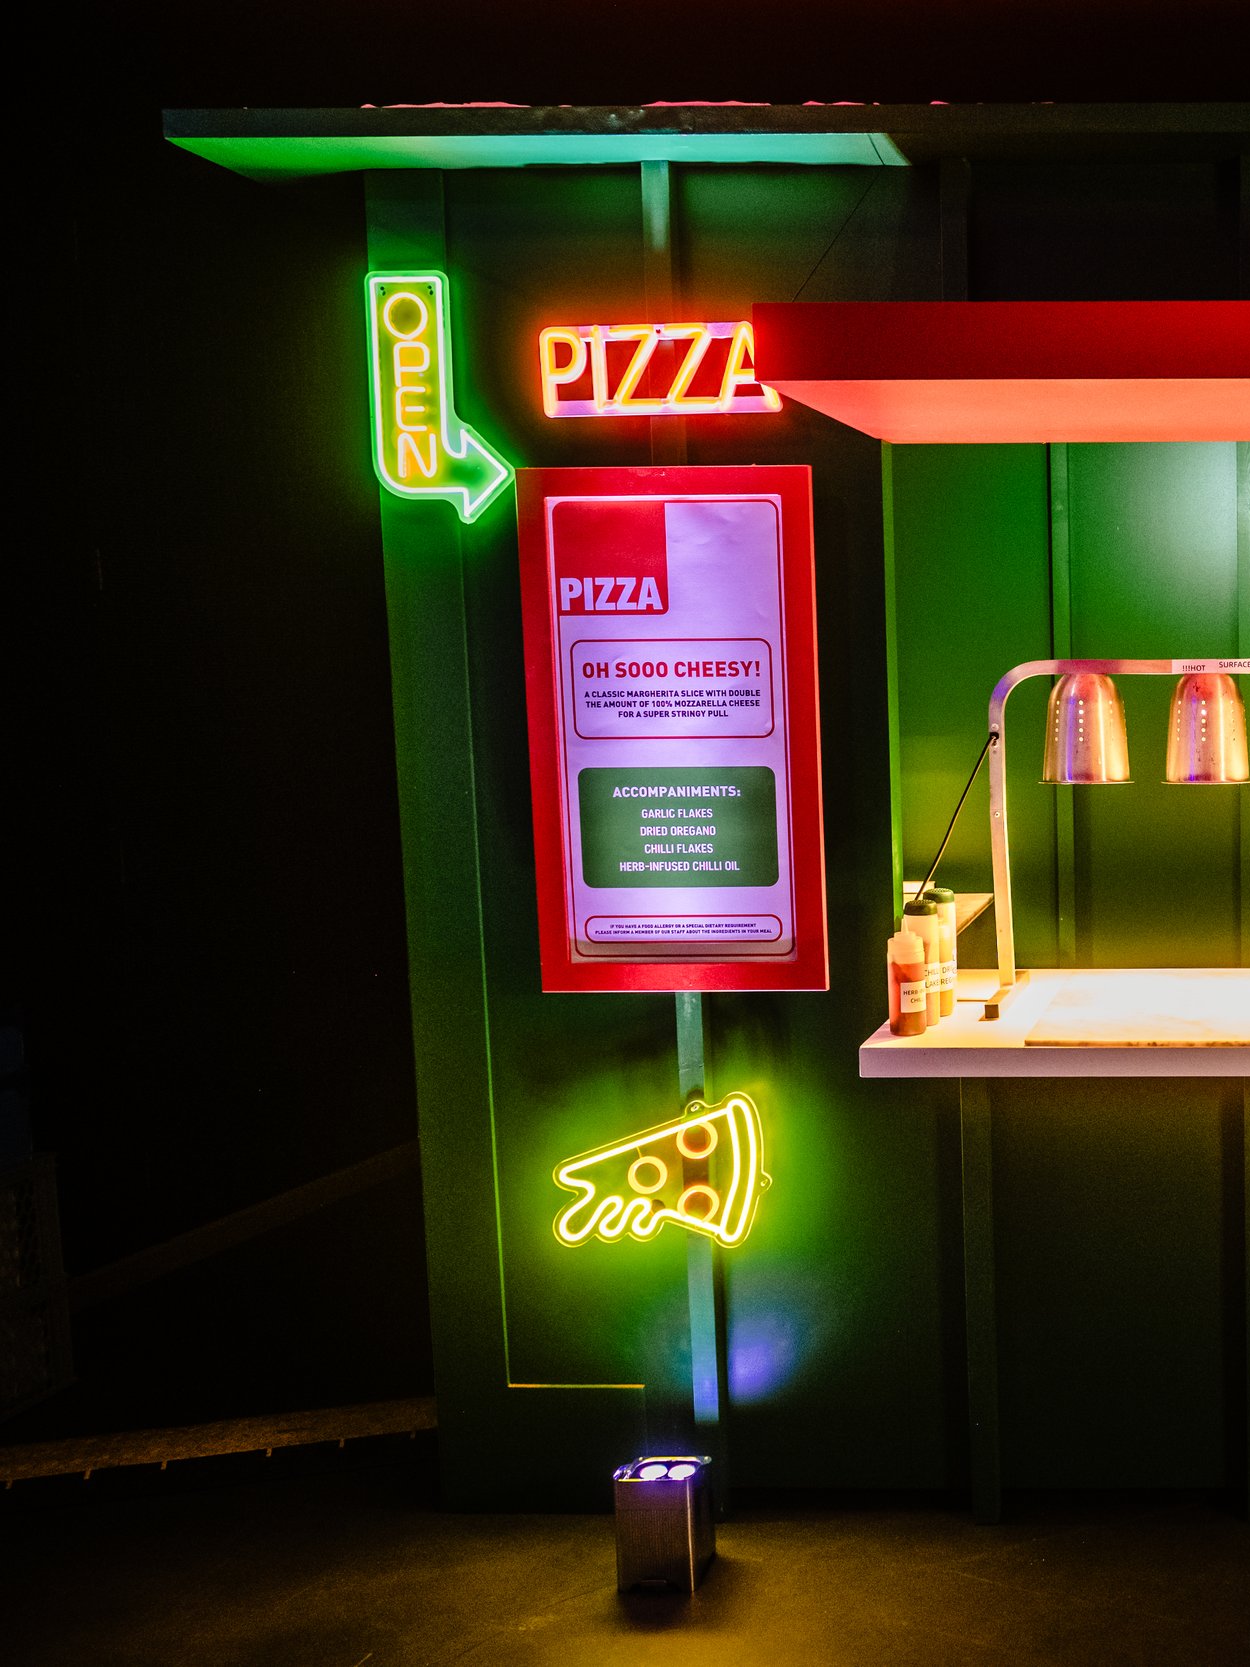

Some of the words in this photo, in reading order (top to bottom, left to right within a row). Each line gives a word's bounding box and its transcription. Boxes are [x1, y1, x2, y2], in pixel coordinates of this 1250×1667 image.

[540, 322, 783, 416] PIZZA
[383, 291, 437, 479] OPEN
[560, 577, 663, 611] PIZZA
[582, 662, 609, 679] OH
[615, 662, 669, 679] SOOO
[674, 661, 761, 678] CHEESY!
[613, 786, 741, 798] ACCOMPANIMENTS:
[641, 809, 675, 818] GARLIC
[677, 809, 713, 818] FLAKES
[640, 826, 668, 836] DRIED
[670, 826, 716, 836] OREGANO
[644, 844, 674, 854] CHILLI
[676, 844, 713, 854] FLAKES
[619, 861, 690, 872] HERB-INFUSED
[692, 861, 722, 872] CHILLI
[725, 860, 740, 871] OIL
